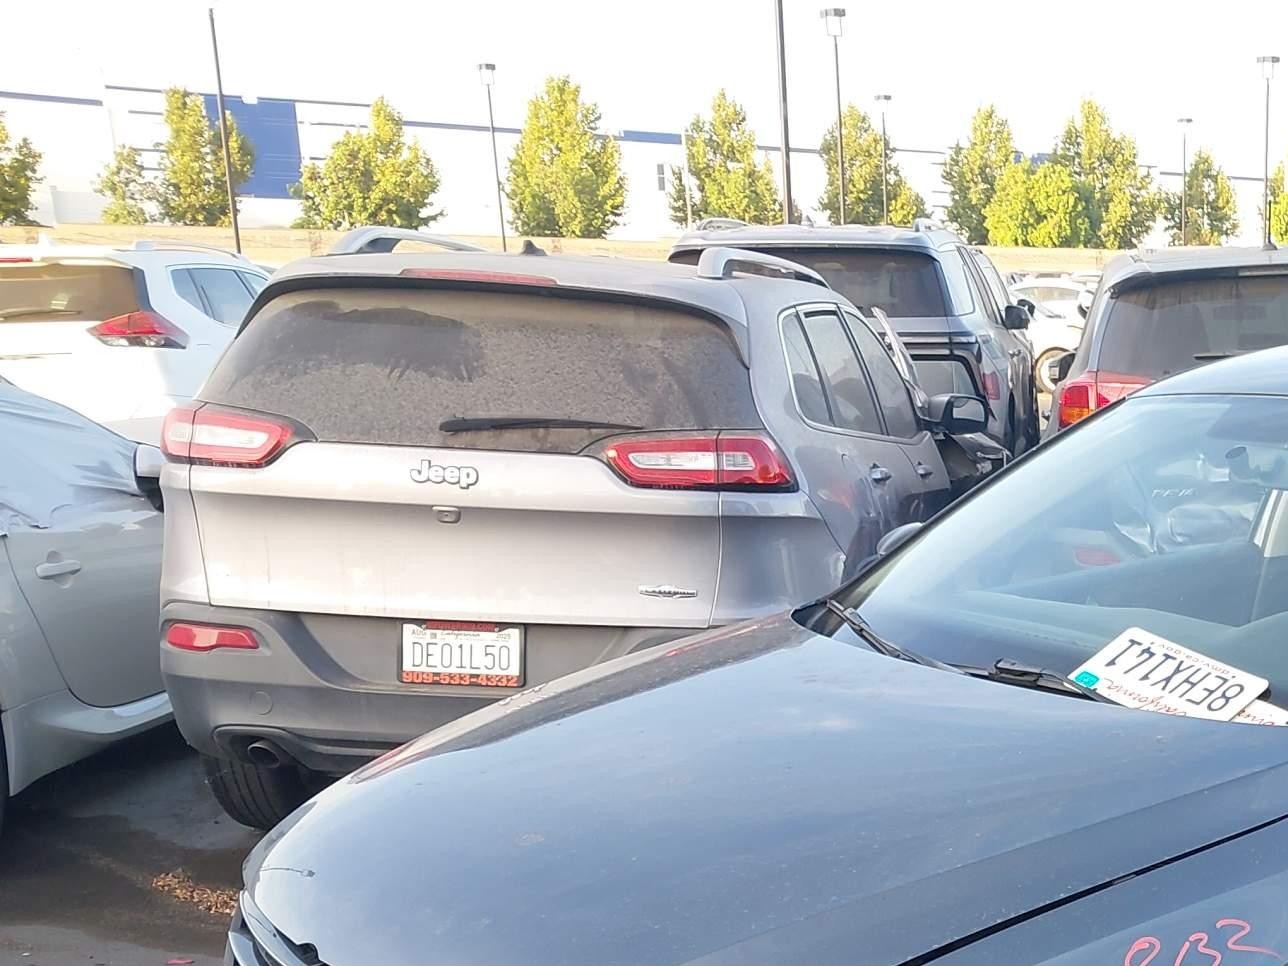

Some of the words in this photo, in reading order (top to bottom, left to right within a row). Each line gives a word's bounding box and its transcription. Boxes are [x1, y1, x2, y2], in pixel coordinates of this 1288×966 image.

[409, 459, 479, 490] Jeep
[412, 641, 510, 671] DE01L50
[402, 672, 519, 687] 909-533-4332
[1104, 638, 1245, 712] 8EHX141
